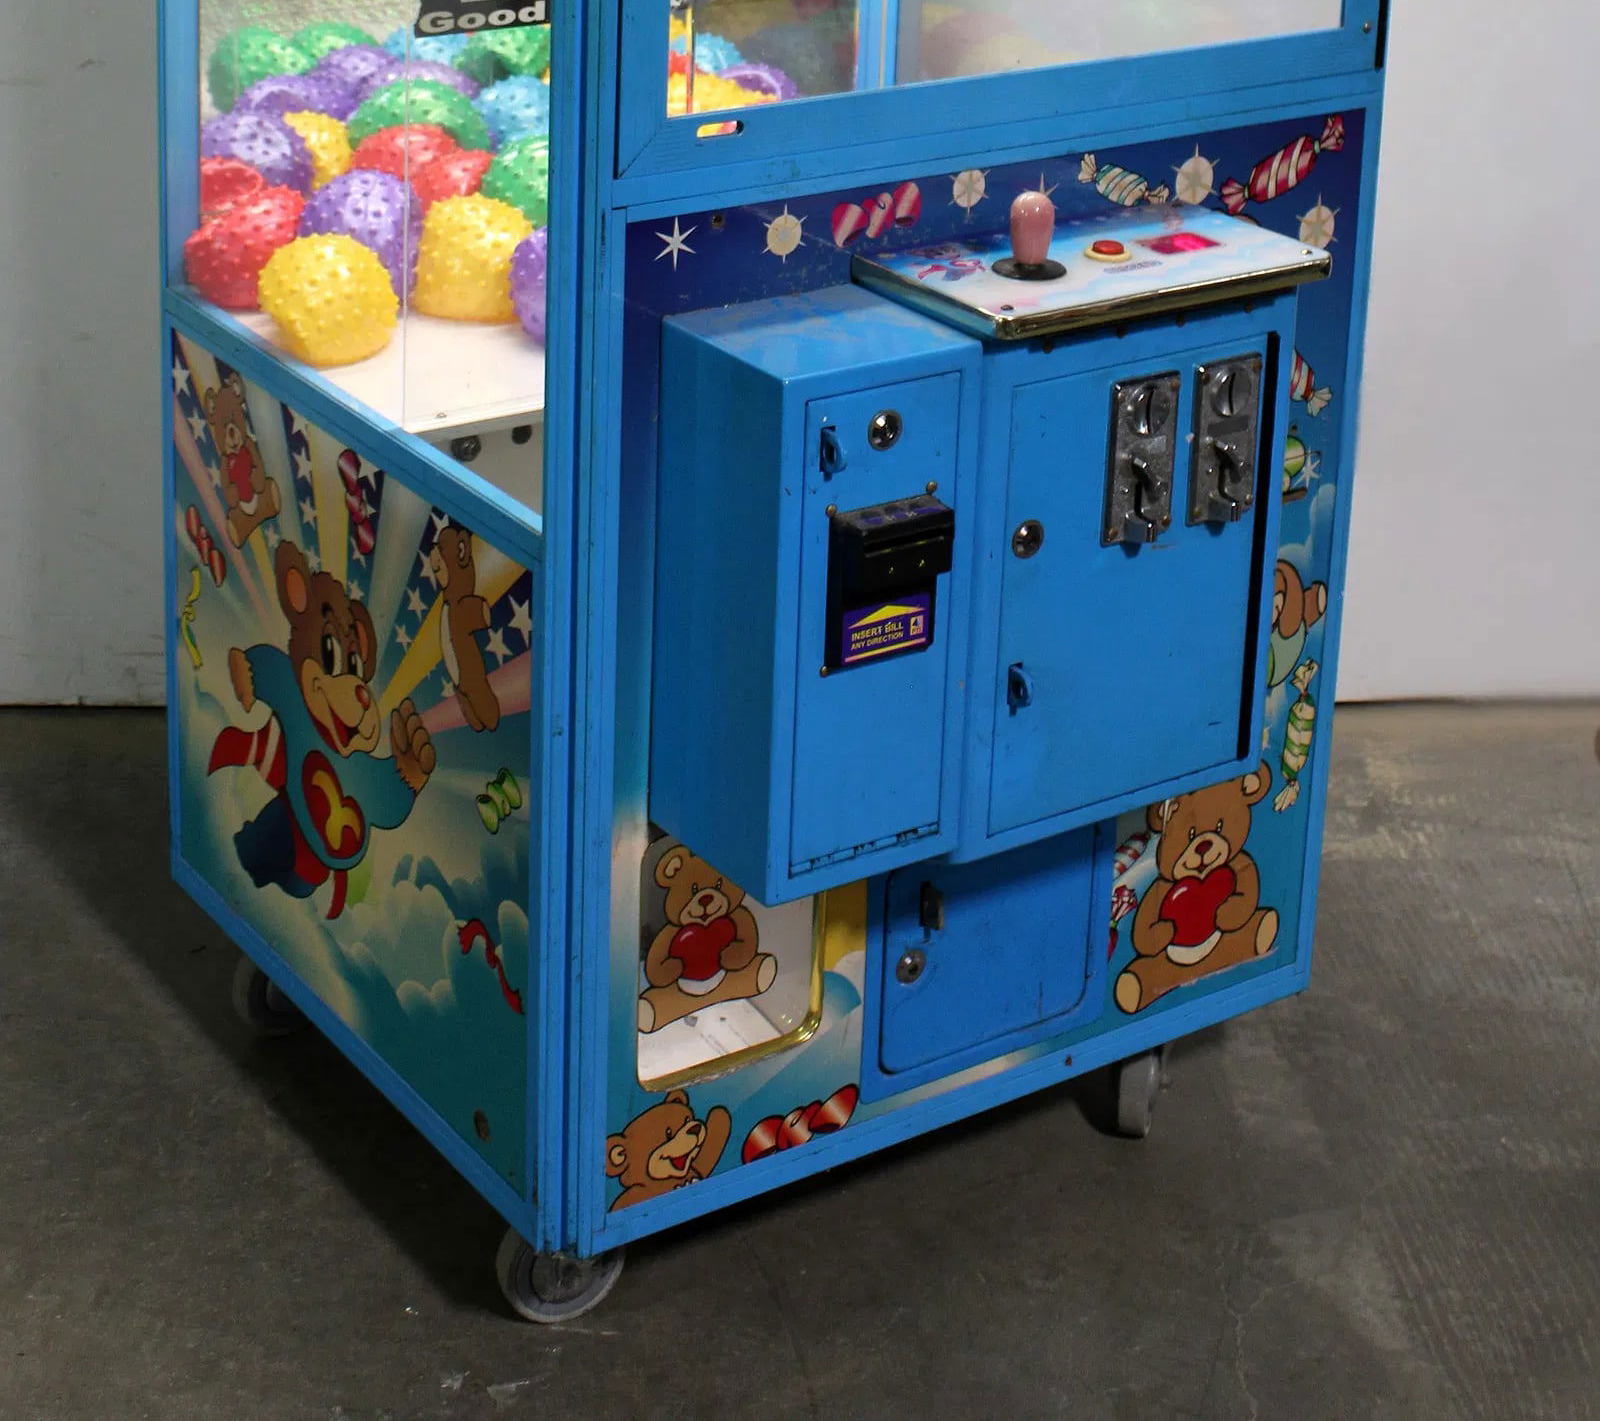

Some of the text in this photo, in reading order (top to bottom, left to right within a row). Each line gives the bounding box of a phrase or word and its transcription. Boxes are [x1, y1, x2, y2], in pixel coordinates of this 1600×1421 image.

[418, 0, 546, 34] Good
[850, 631, 904, 651] ANY DIRECTION
[851, 626, 883, 642] INSERT
[884, 621, 904, 633] BILL
